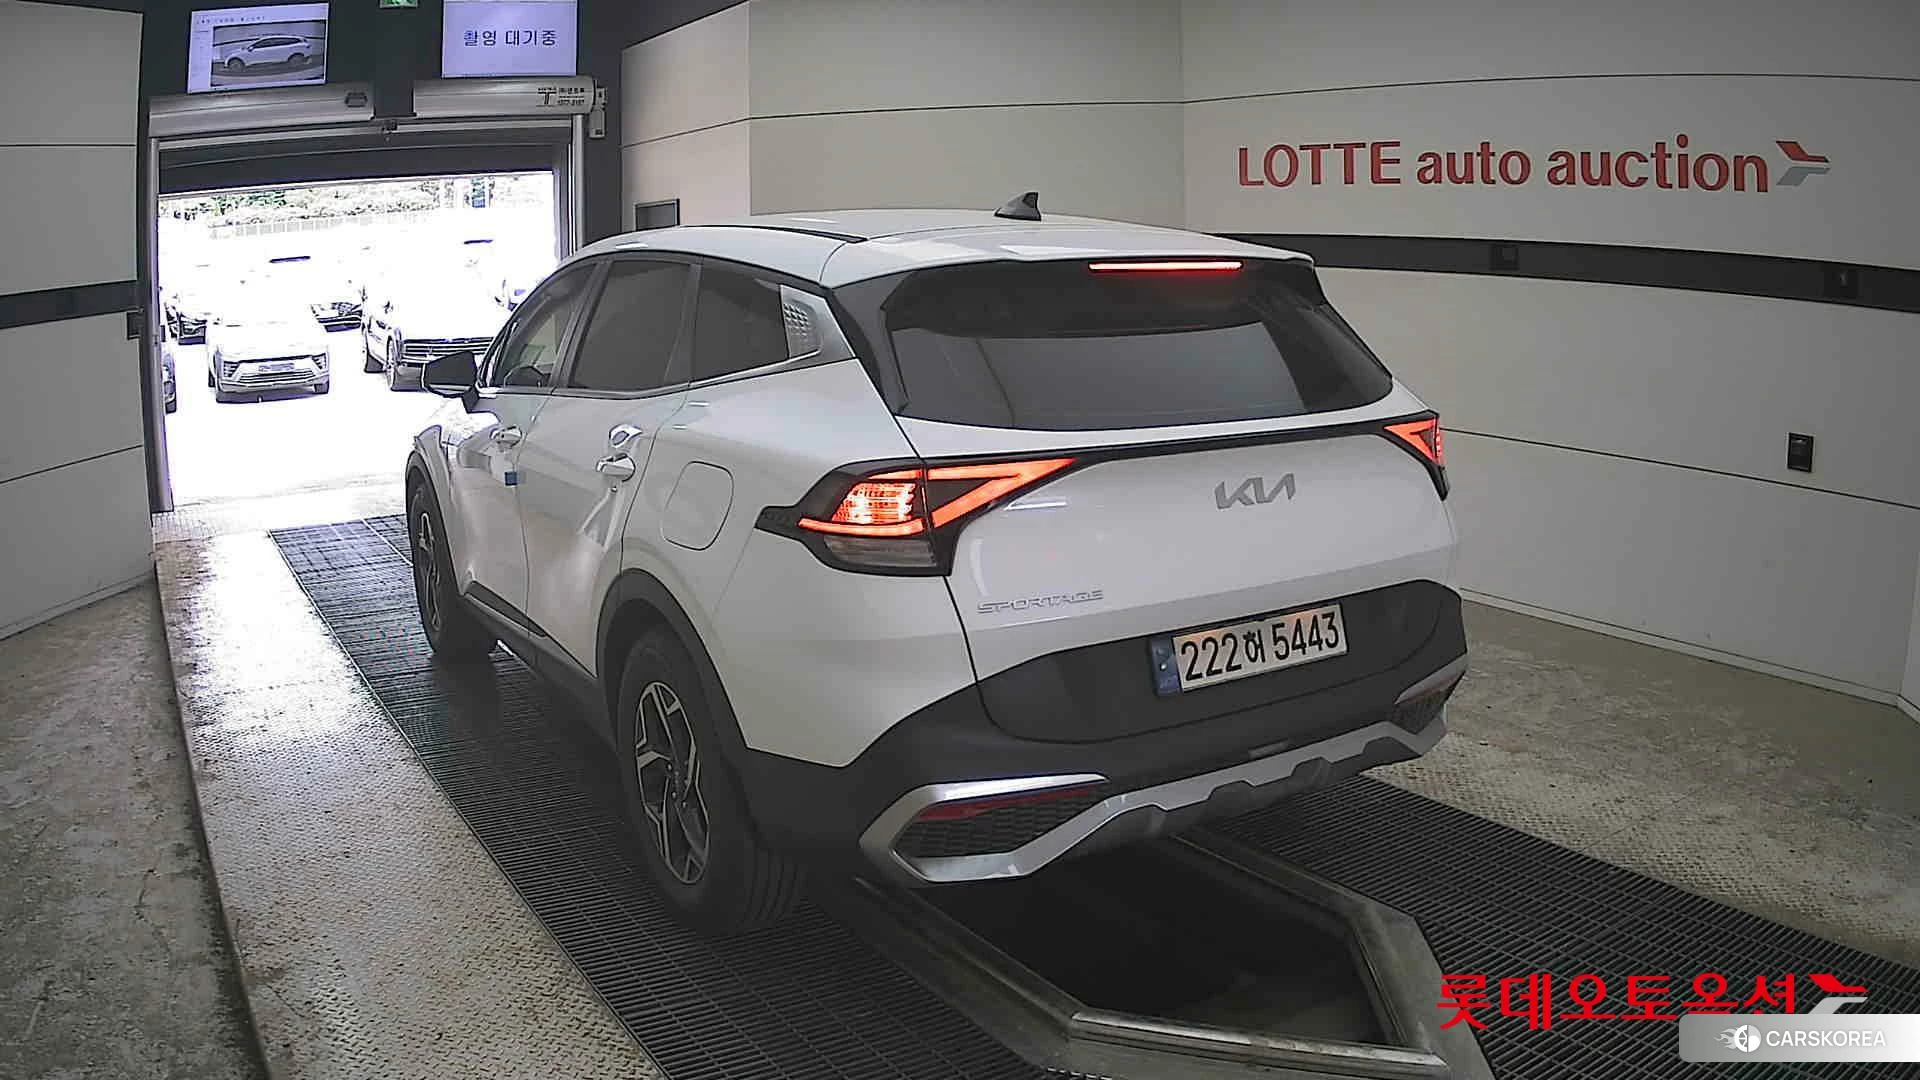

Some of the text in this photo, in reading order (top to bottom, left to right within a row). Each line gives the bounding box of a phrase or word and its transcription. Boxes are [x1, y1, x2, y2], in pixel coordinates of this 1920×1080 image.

[463, 29, 557, 47] 촬영 대기중
[1238, 134, 1770, 194] LOTTE auto auction
[1214, 473, 1296, 509] KIA
[977, 590, 1104, 614] SPORTAGE
[1271, 611, 1340, 661] 5443
